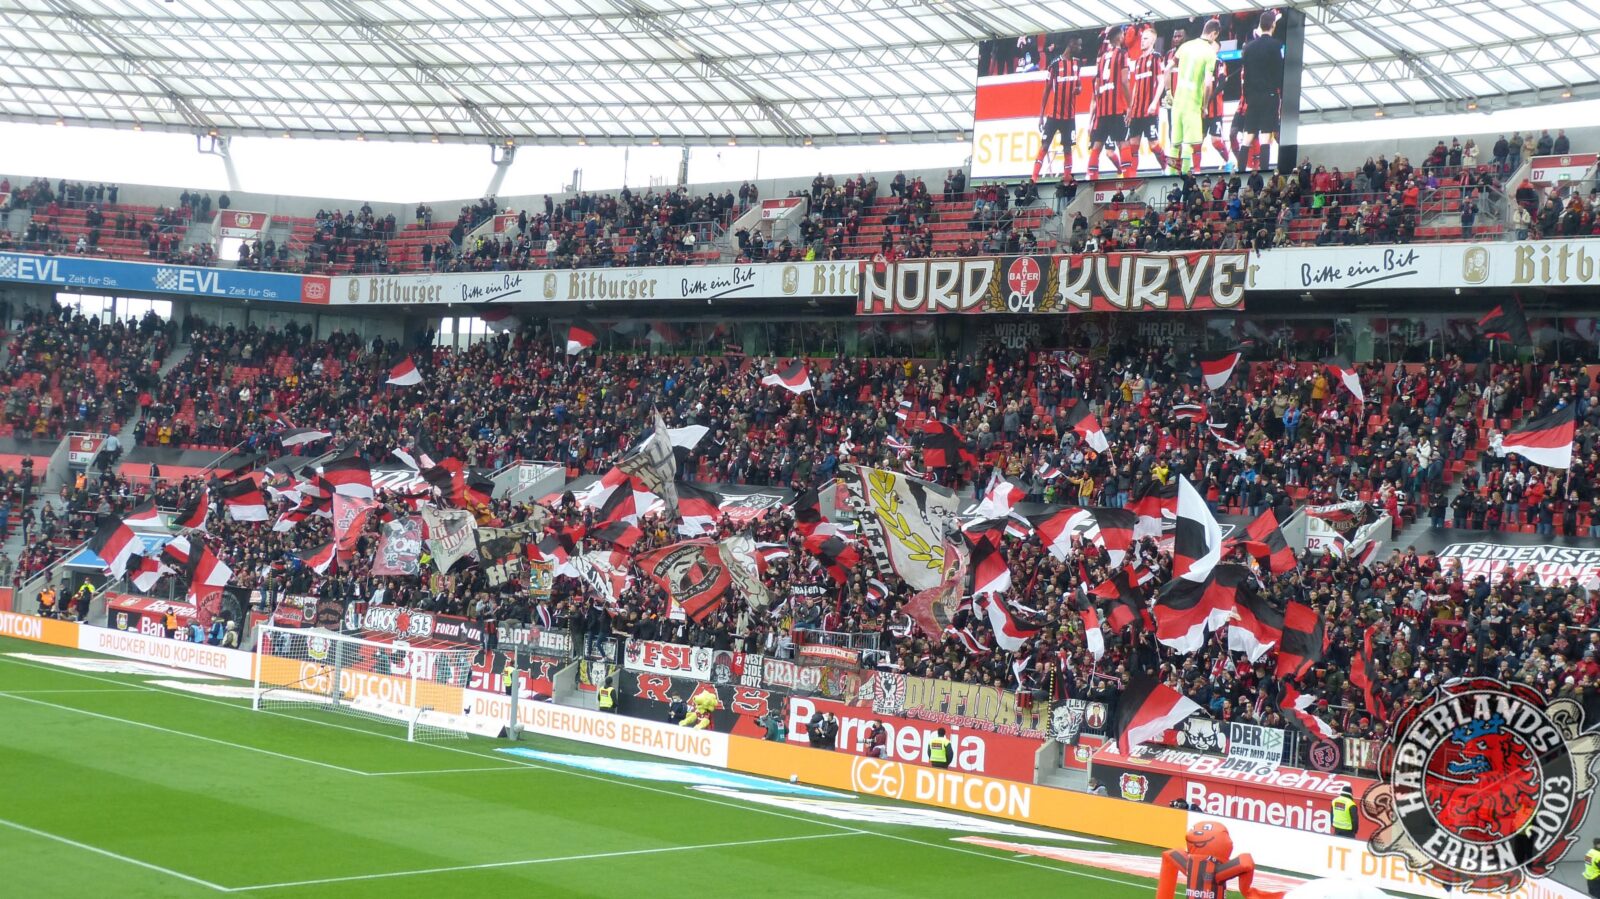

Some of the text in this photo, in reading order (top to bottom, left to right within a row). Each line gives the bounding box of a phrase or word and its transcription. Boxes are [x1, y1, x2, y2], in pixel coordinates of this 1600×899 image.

[1533, 169, 1545, 181] D7
[17, 257, 118, 287] EVL Zeit für Sie.
[1009, 271, 1039, 281] BAYER
[1301, 248, 1421, 288] Bitte ein Bit
[1511, 243, 1596, 283] Bitb
[178, 268, 279, 299] EVL Zeit für Sie.
[368, 276, 443, 303] Bitburger
[461, 274, 522, 302] Bitte ein Bit
[567, 272, 658, 299] Bitburger
[681, 267, 757, 297] Bitte ein Bit
[811, 264, 858, 295] Bitb
[864, 258, 995, 313] NORD
[1058, 253, 1246, 312] KURVE
[1008, 291, 1035, 313] 04
[995, 320, 1040, 337] WIR FÜR
[1138, 320, 1186, 336] IHR FÜR
[1308, 538, 1320, 549] D2
[0, 612, 42, 640] ITCON
[435, 622, 460, 637] FORZA
[100, 632, 228, 670] DRUCKER UND KOPIERER
[642, 640, 693, 672] FSI
[743, 664, 762, 677] SIDE
[339, 670, 407, 705] DITCON
[621, 724, 713, 758] BERATUNG
[1231, 723, 1261, 747] DER
[1222, 757, 1254, 773] DEN
[1230, 747, 1281, 763] GEHT MIR AUF
[915, 768, 1031, 818] DITCON
[1185, 781, 1332, 835] Barmenia
[1327, 845, 1352, 871] IT
